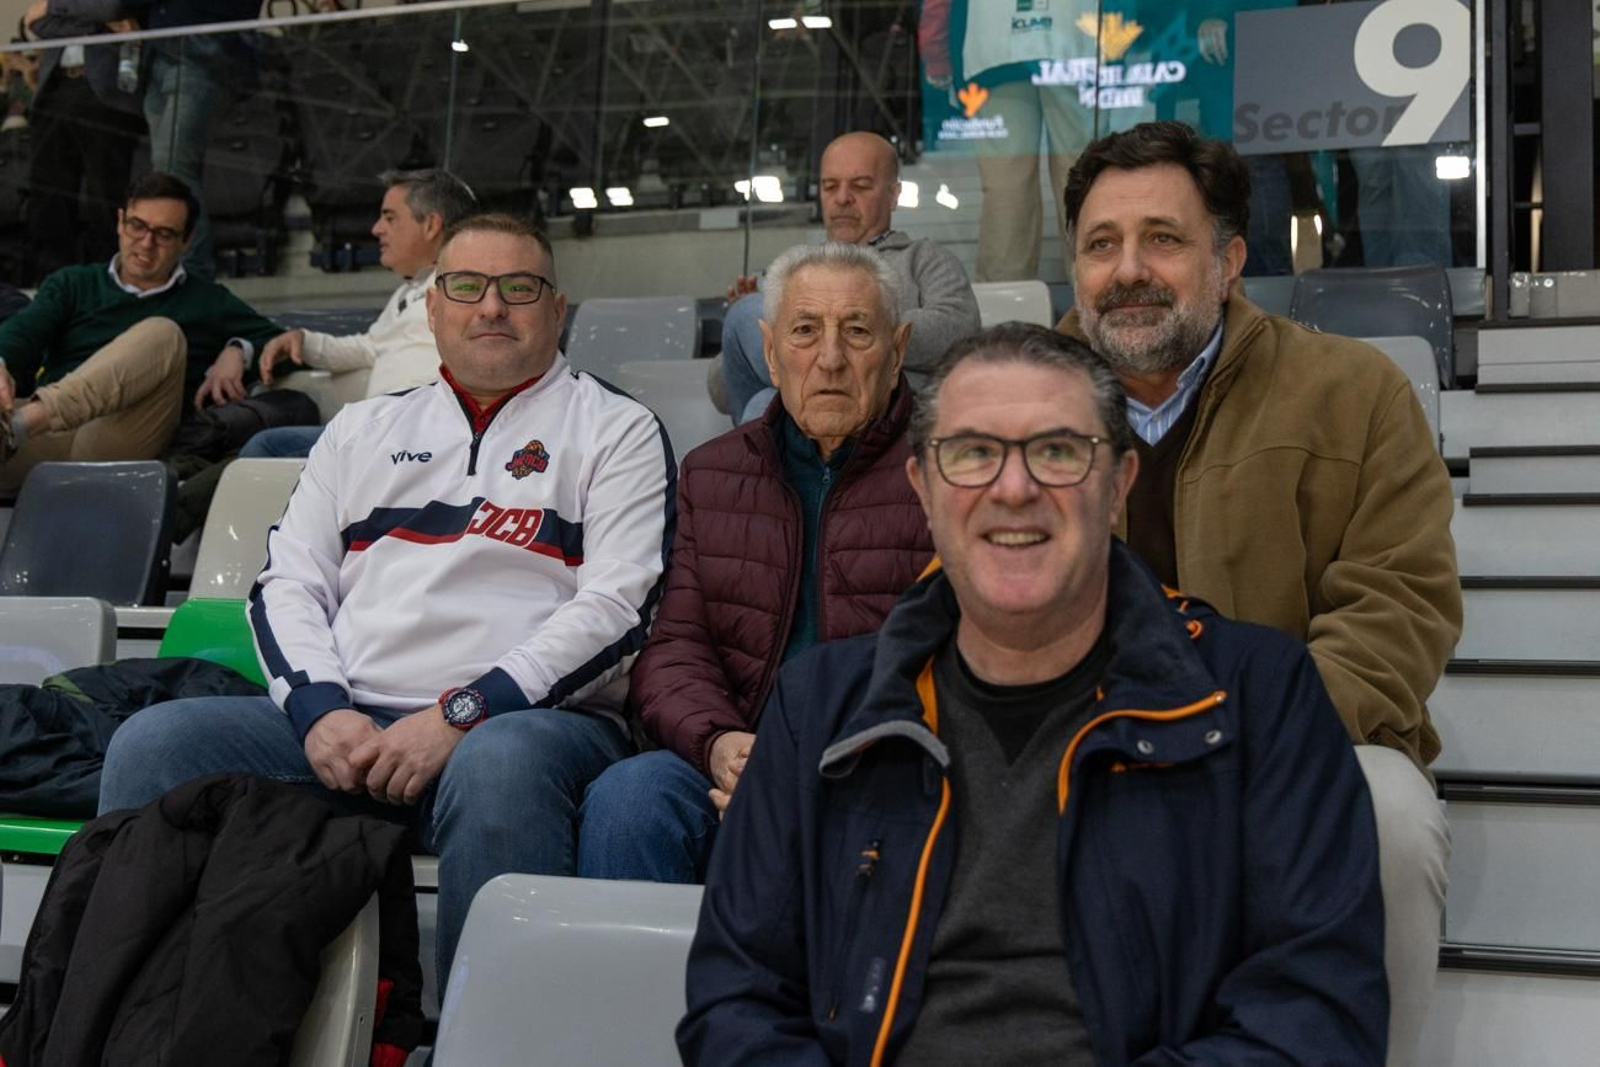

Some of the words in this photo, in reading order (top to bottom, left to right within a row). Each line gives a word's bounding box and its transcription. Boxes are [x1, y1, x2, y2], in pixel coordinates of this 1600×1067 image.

[1354, 0, 1471, 146] 9
[1234, 101, 1409, 144] Sector
[390, 450, 433, 466] vive
[466, 500, 543, 548] JCB
